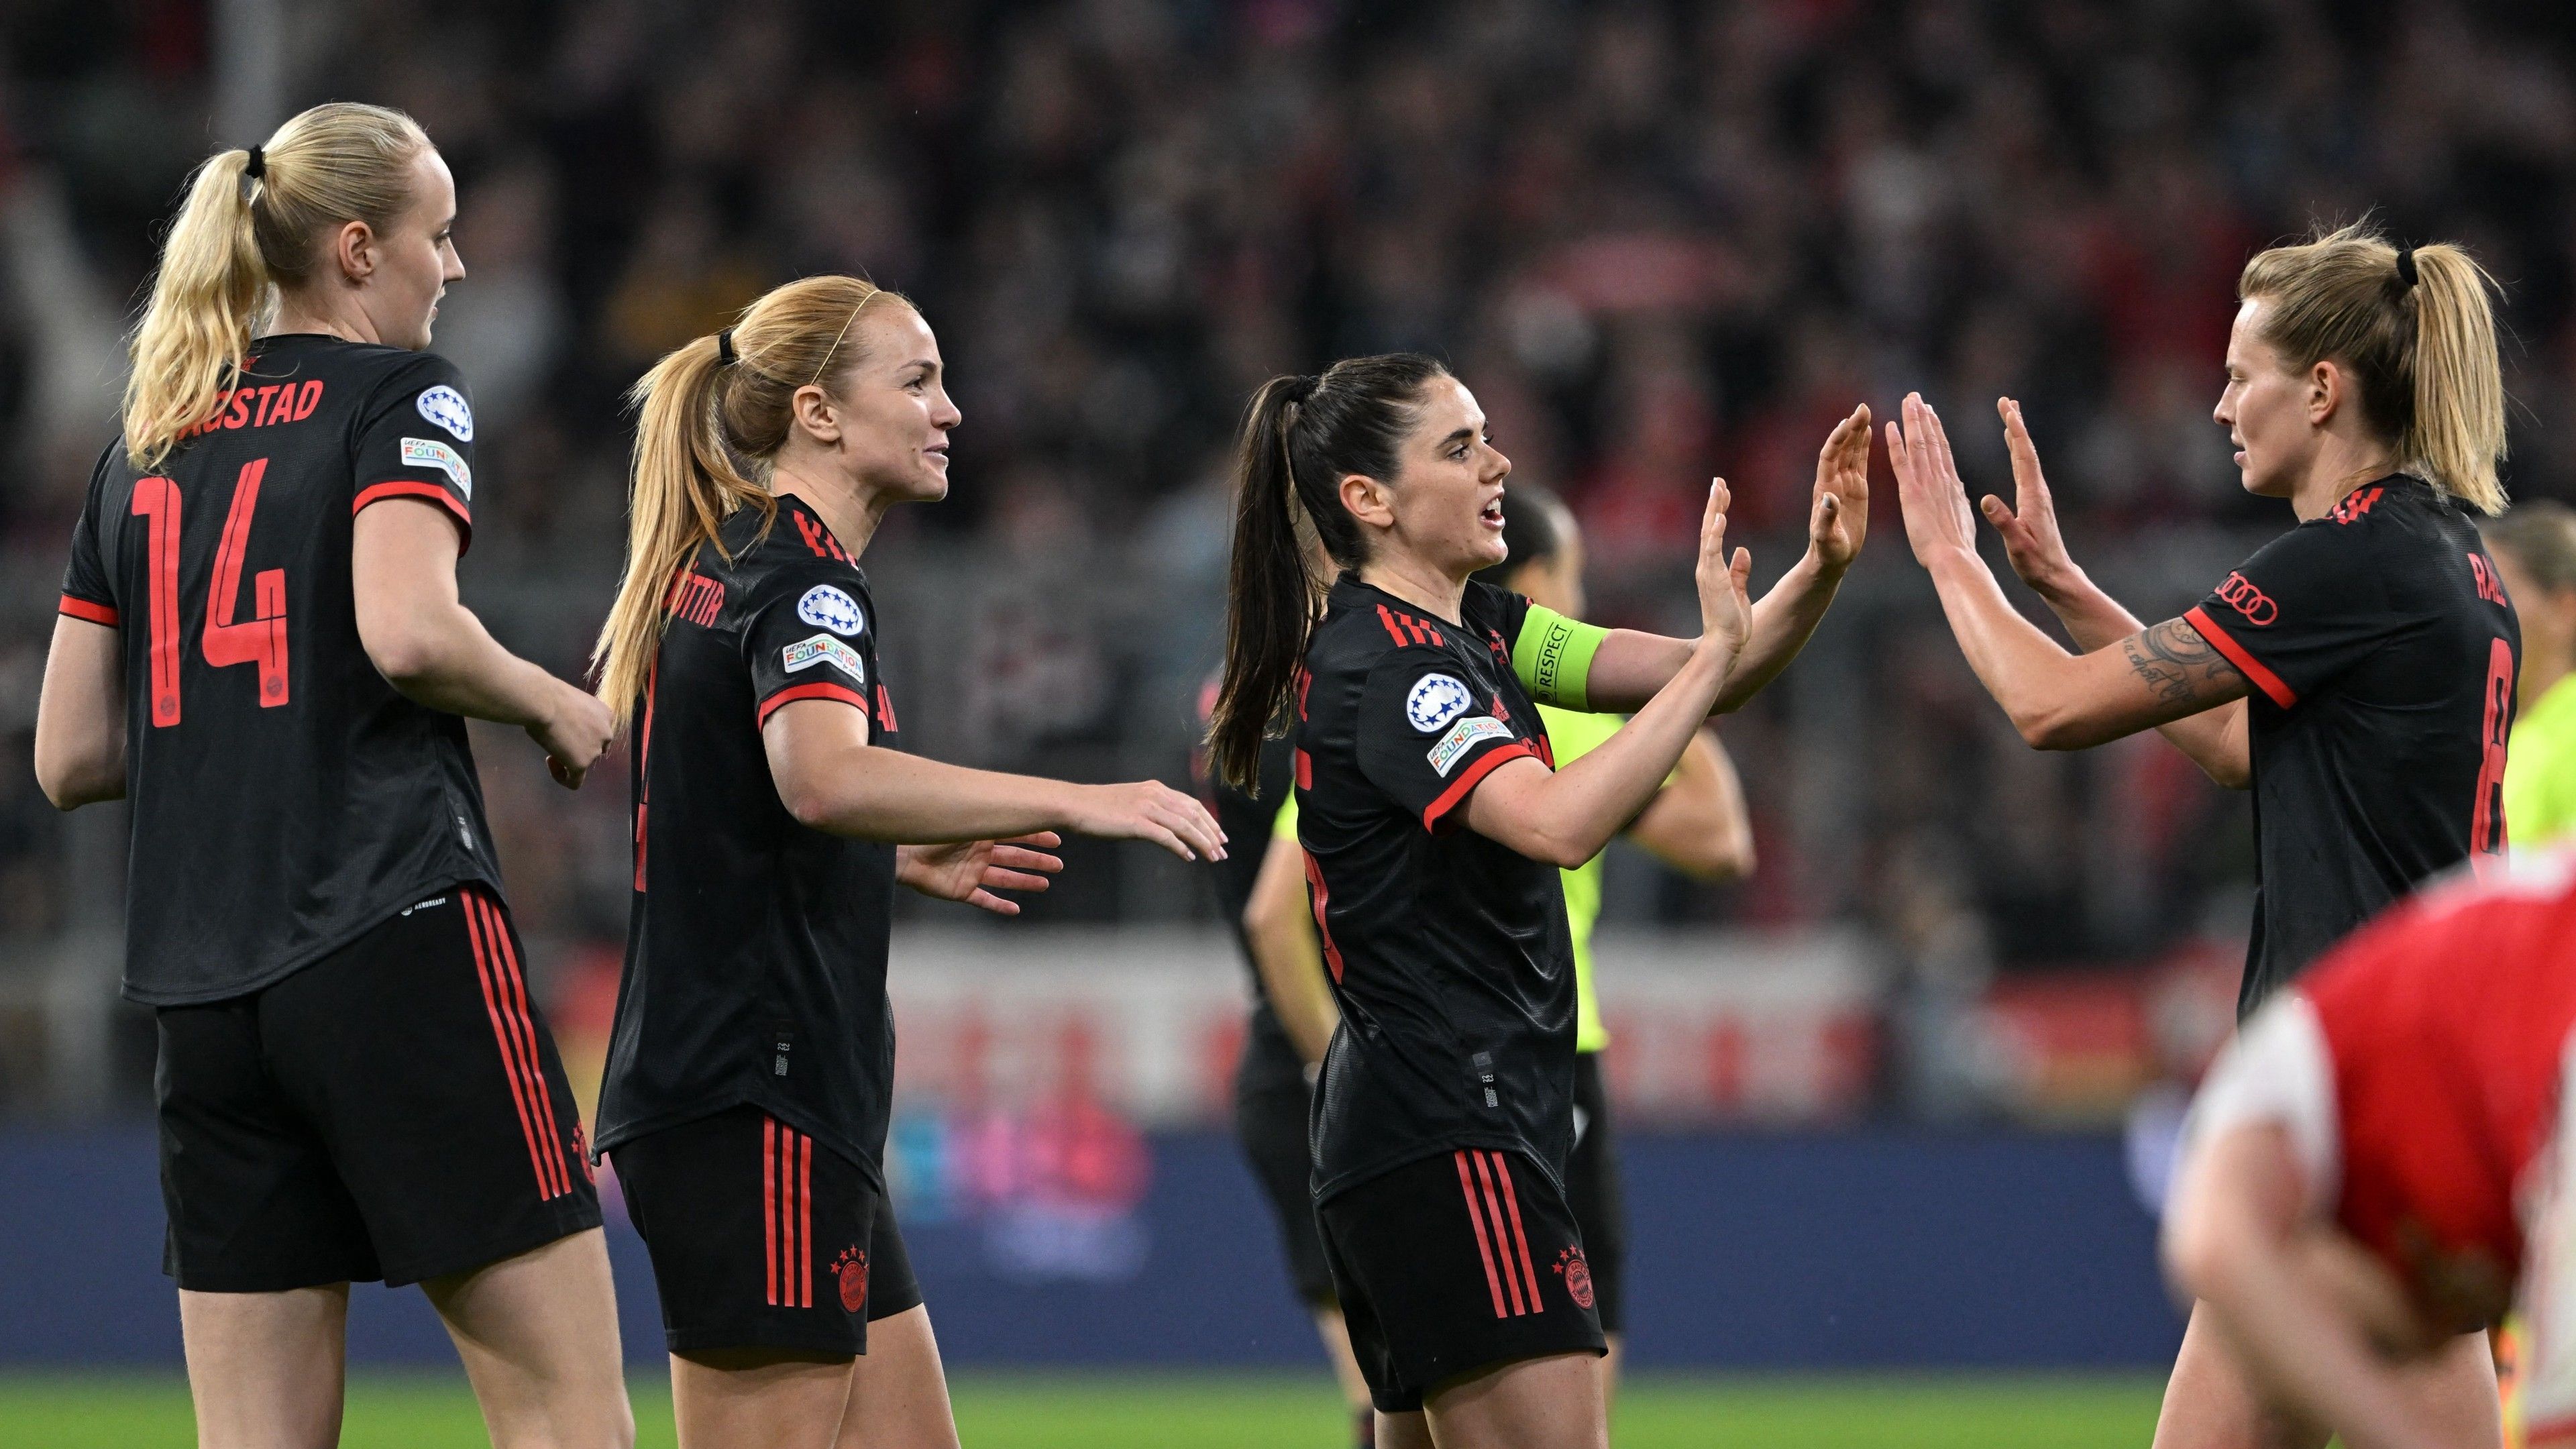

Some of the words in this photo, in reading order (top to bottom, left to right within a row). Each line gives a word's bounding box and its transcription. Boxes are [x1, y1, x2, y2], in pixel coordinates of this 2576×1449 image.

[131, 458, 289, 727] 14
[786, 643, 806, 653] UEFA
[786, 642, 861, 673] FOUNDATION
[1540, 624, 1567, 688] RESPECT
[1430, 741, 1446, 759] UEFA
[2469, 637, 2513, 887] 8
